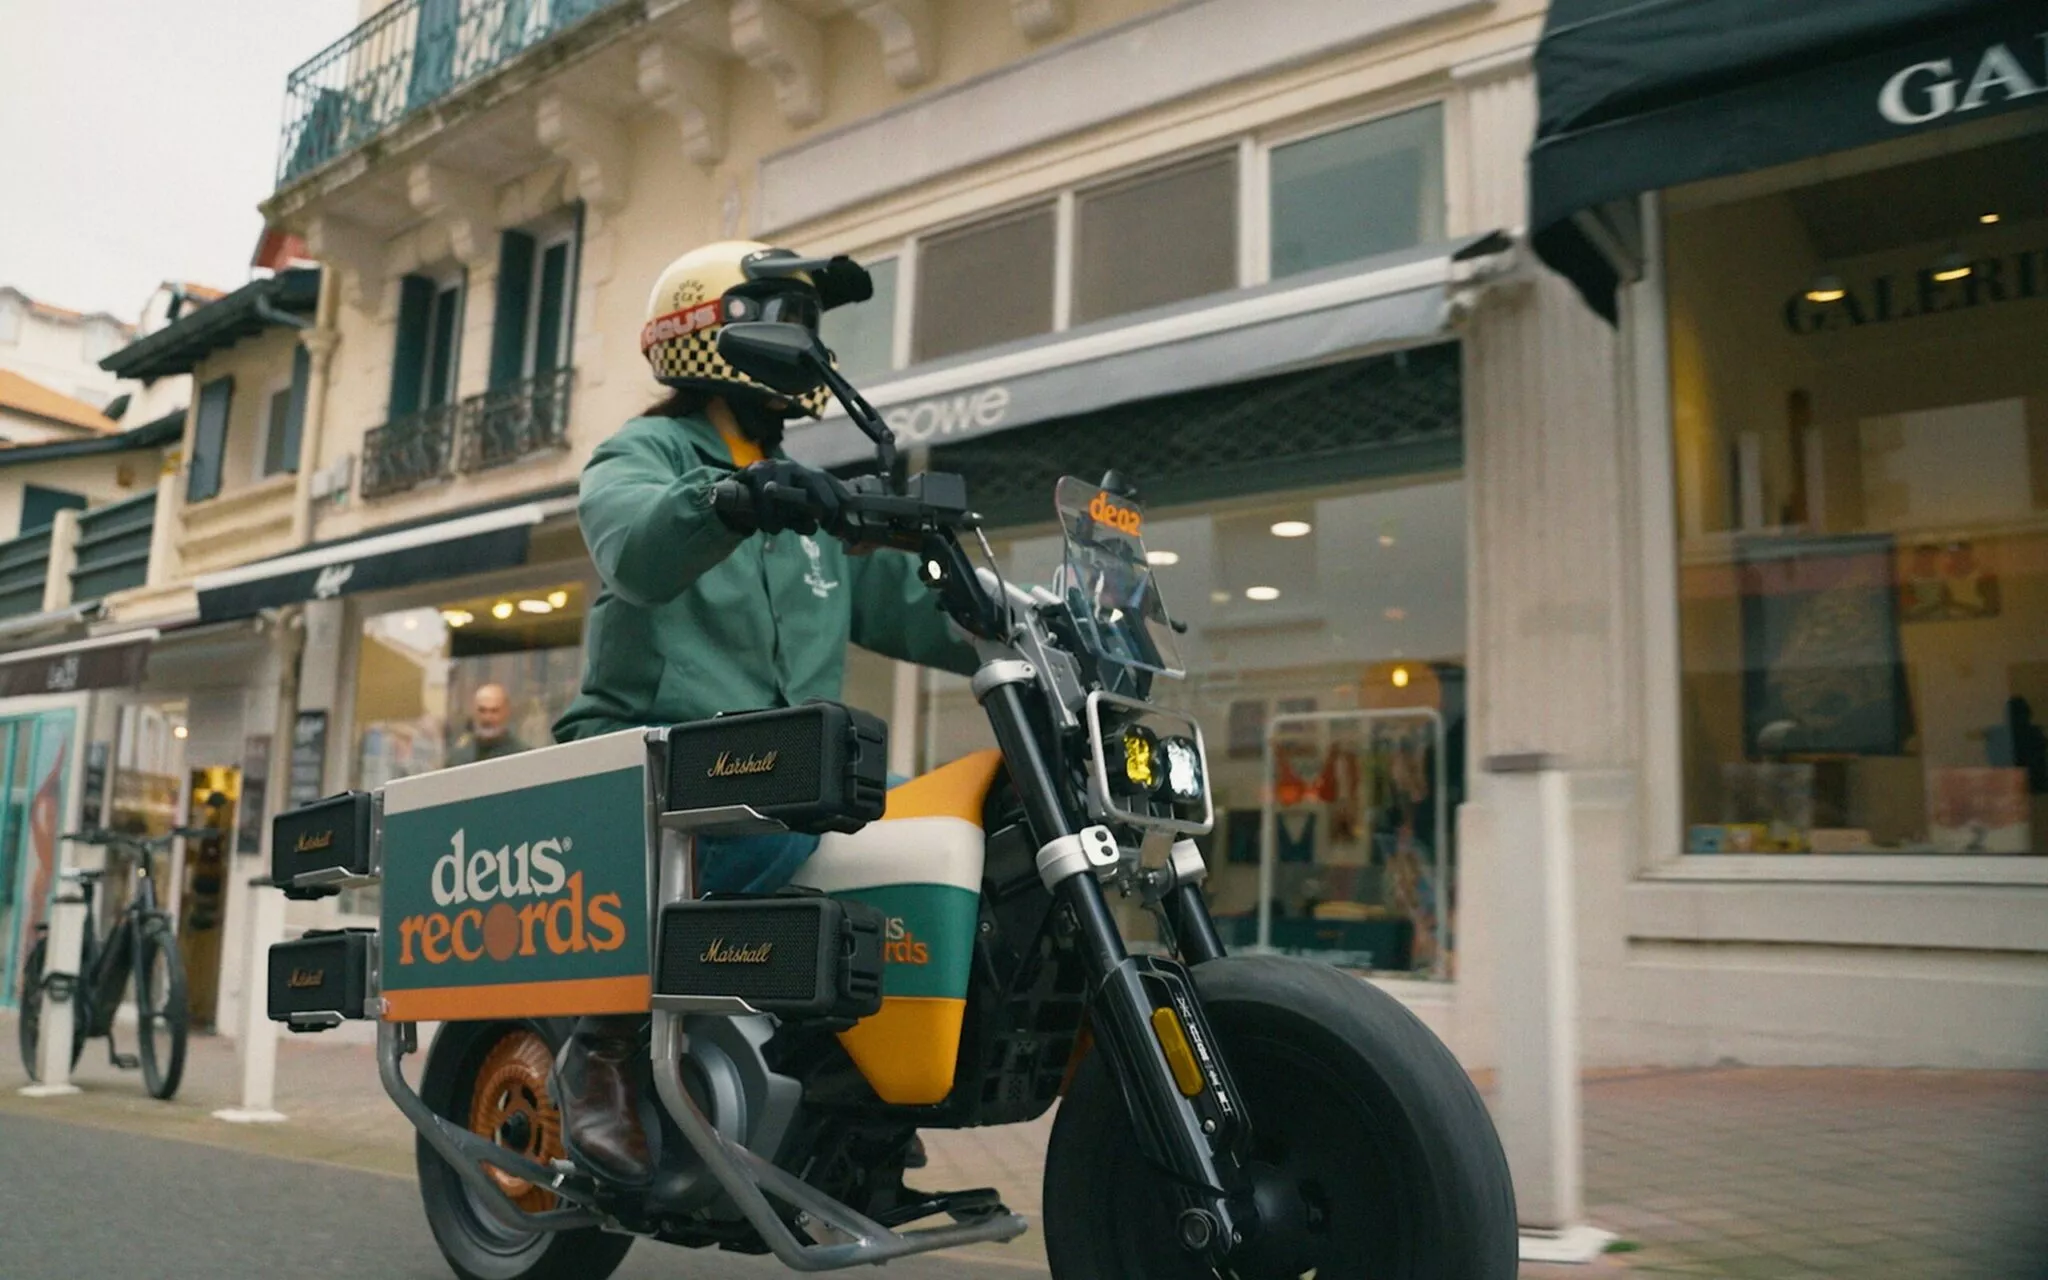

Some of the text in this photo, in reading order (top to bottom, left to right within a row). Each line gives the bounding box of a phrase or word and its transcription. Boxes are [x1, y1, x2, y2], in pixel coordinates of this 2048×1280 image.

[1877, 32, 2048, 125] GA
[1784, 249, 2048, 334] GALERI
[884, 387, 1009, 445] sowe
[707, 750, 777, 777] Marshall
[700, 937, 772, 963] Marshall
